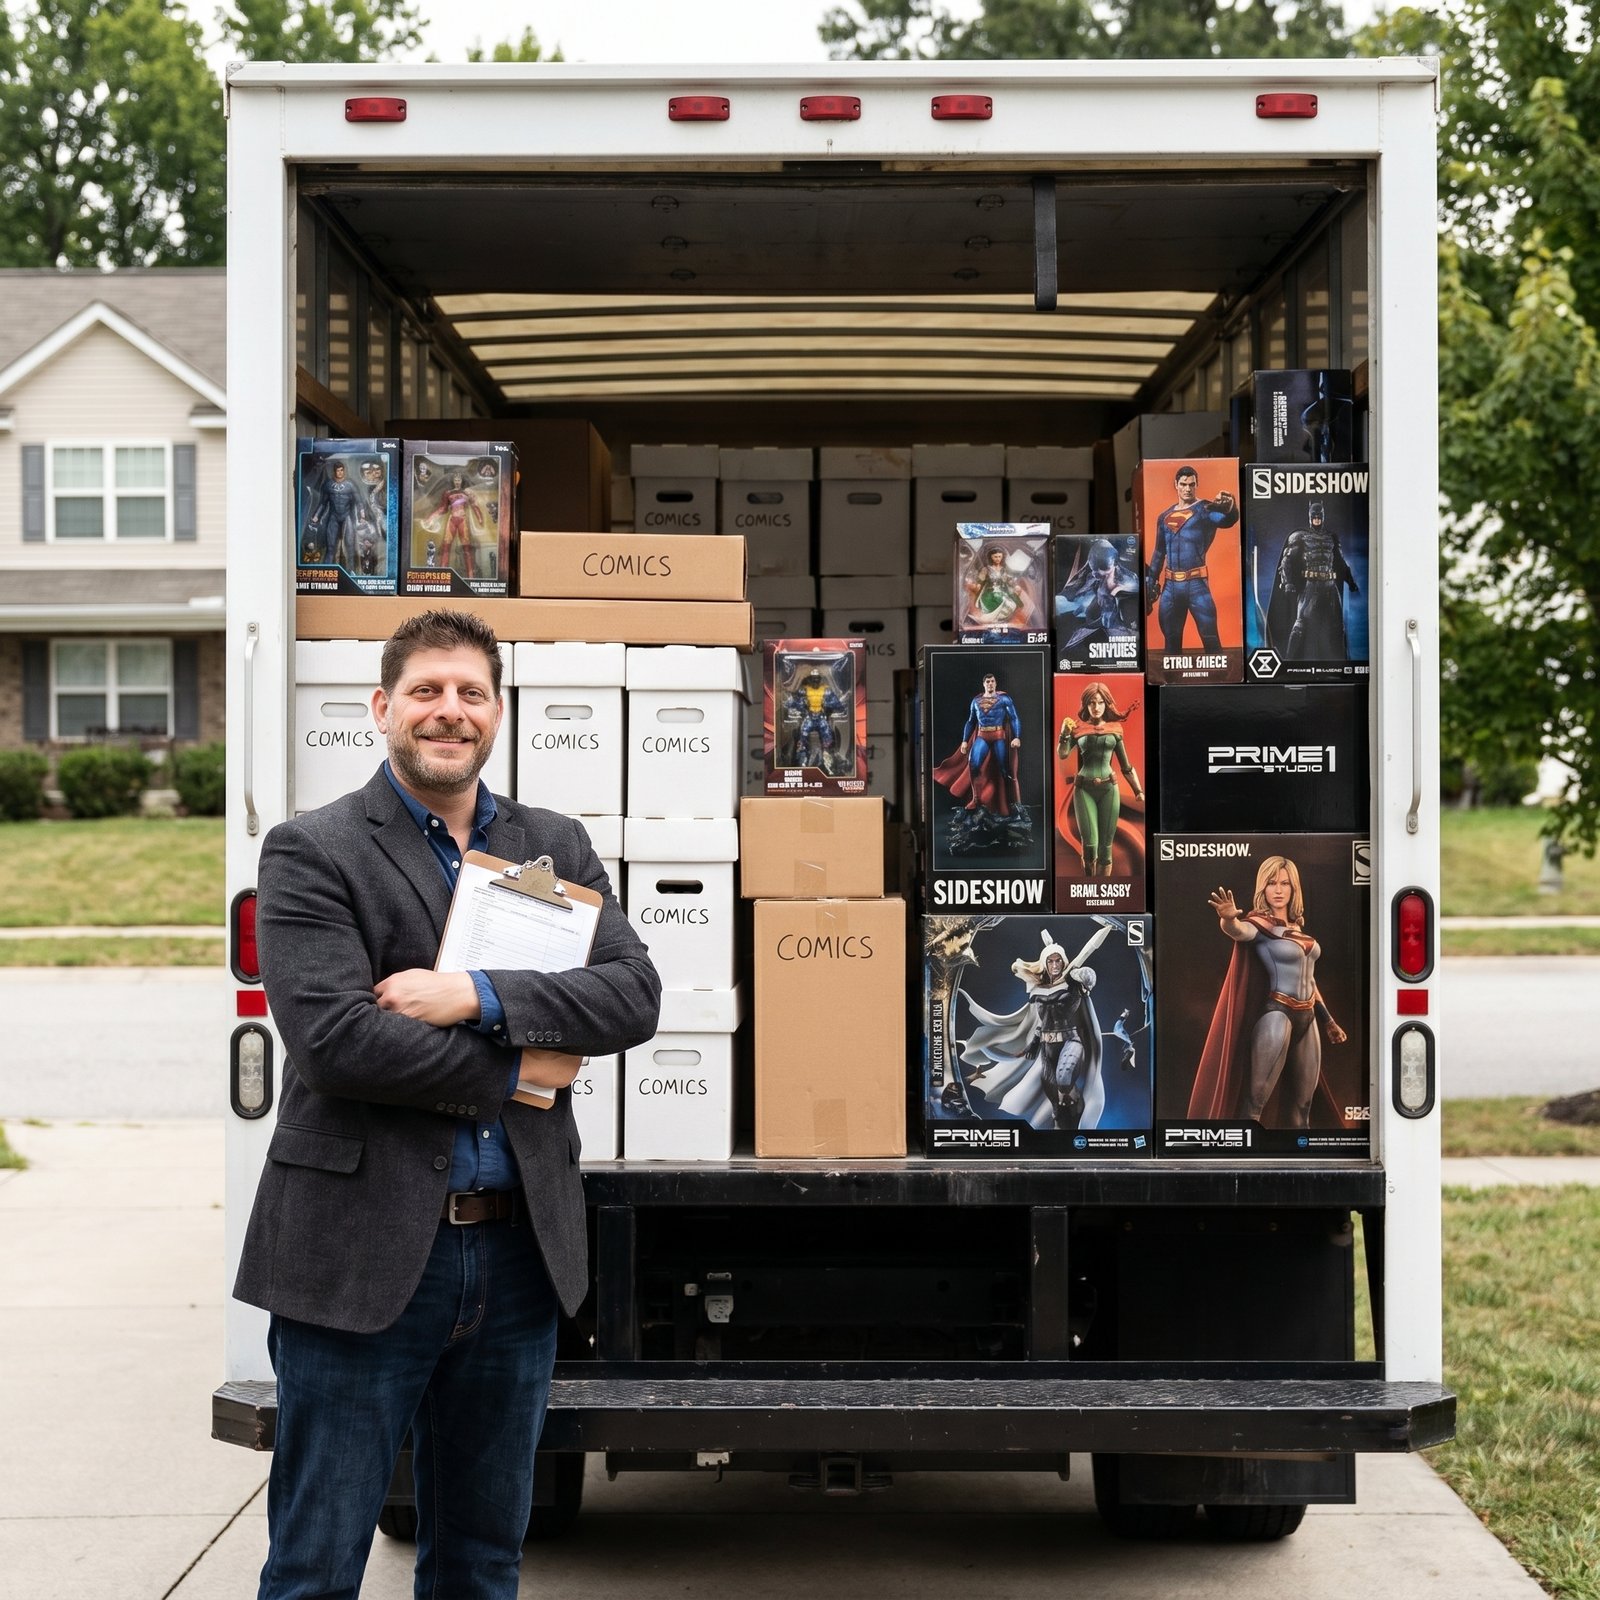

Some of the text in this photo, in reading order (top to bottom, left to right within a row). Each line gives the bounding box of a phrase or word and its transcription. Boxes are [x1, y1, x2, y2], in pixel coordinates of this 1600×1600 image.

[1274, 472, 1368, 494] SIDESHOW
[644, 511, 701, 527] COMICS
[735, 513, 791, 528] COMICS
[583, 553, 671, 577] COMICS
[306, 730, 374, 747] COMICS
[531, 733, 599, 750] COMICS
[643, 737, 709, 754] COMICS
[1263, 764, 1323, 773] STUDIO
[933, 879, 1044, 905] SIDESHOW
[641, 908, 709, 926] COMICS
[777, 934, 874, 961] COMICS
[639, 1079, 708, 1096] COMICS
